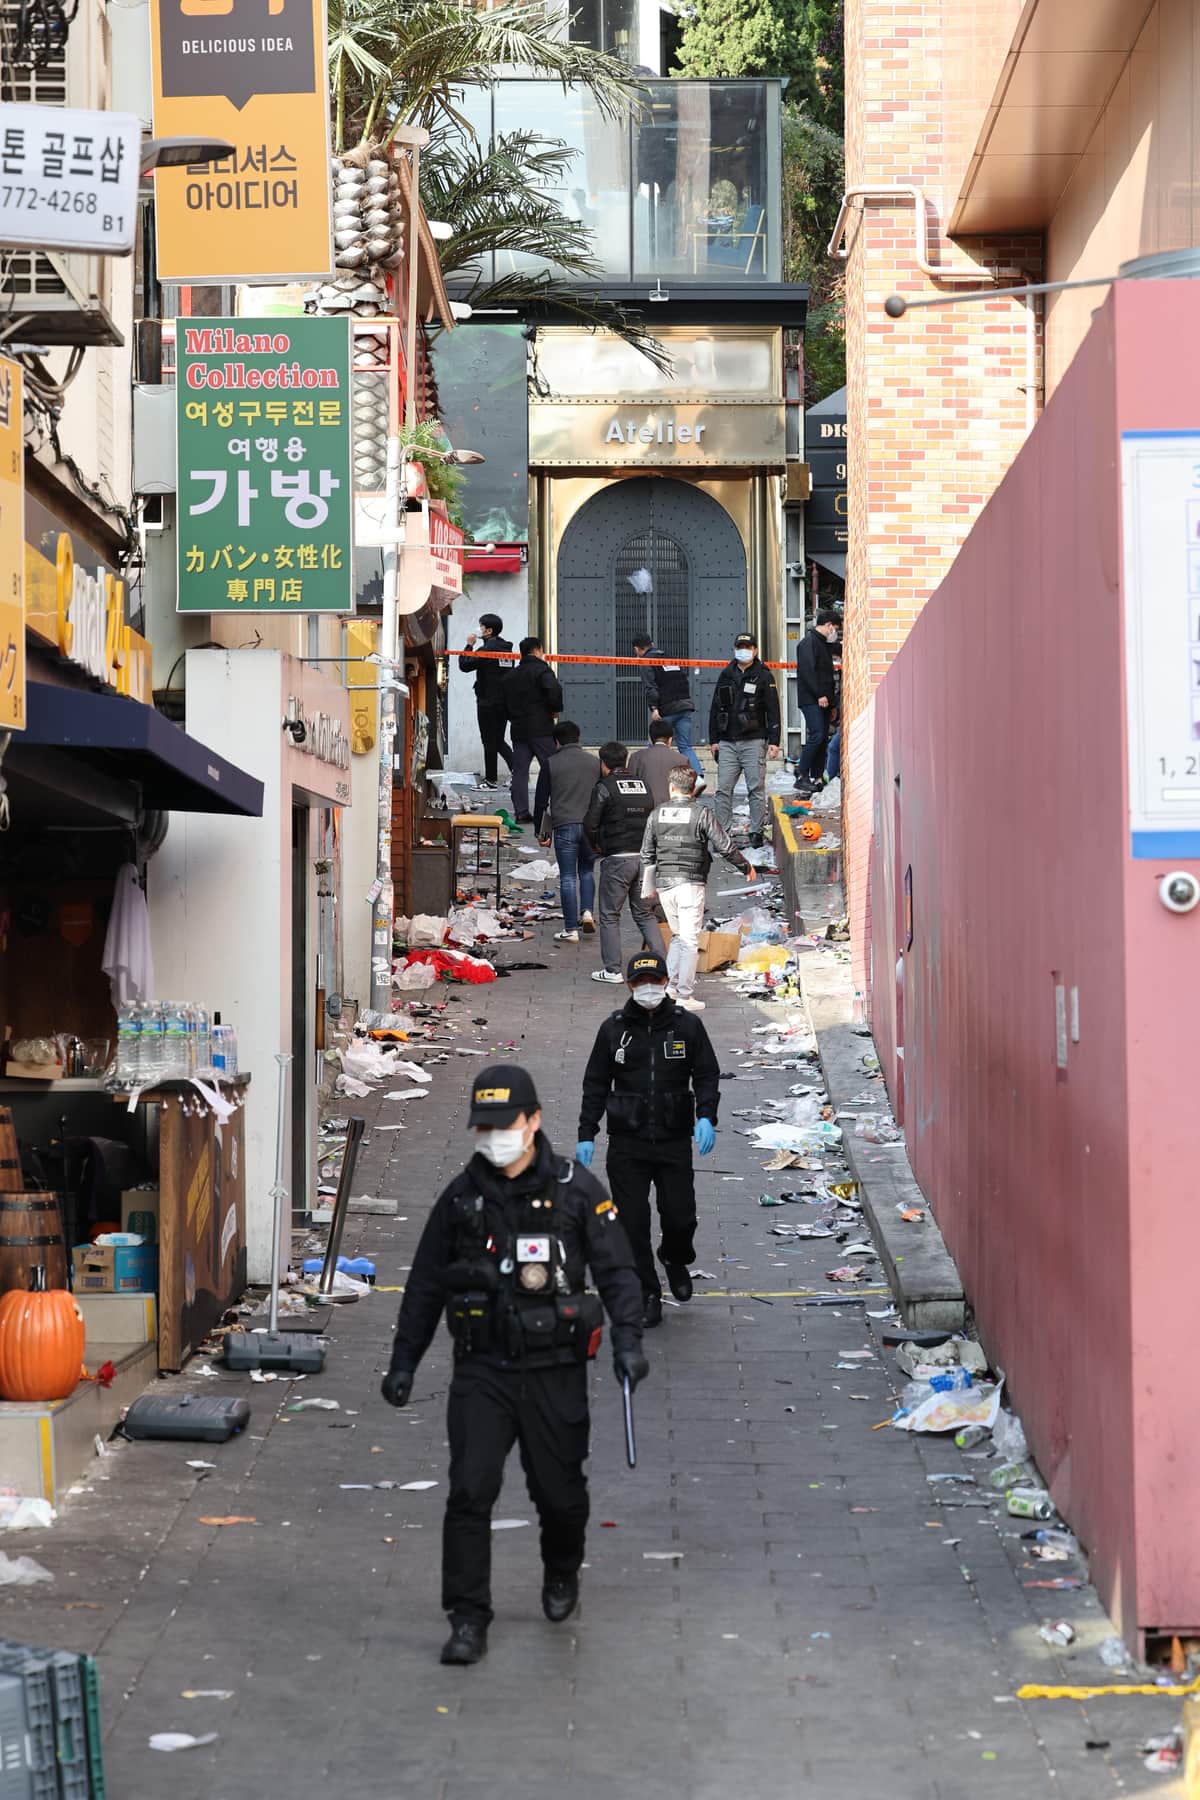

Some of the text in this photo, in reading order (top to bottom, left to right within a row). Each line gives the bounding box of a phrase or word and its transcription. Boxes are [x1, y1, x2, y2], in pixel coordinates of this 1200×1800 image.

[182, 37, 294, 54] DELICIOUS IDEA
[2, 128, 124, 184] 톤 골프샵
[2, 185, 97, 214] 772-4268
[186, 179, 298, 211] 아이디어
[102, 214, 124, 232] B1
[185, 327, 290, 354] Milano
[186, 362, 339, 389] Collection
[186, 400, 341, 427] 여성구두전문
[604, 419, 706, 444] Atelier
[227, 436, 307, 463] 여행용
[189, 469, 341, 529] 가방
